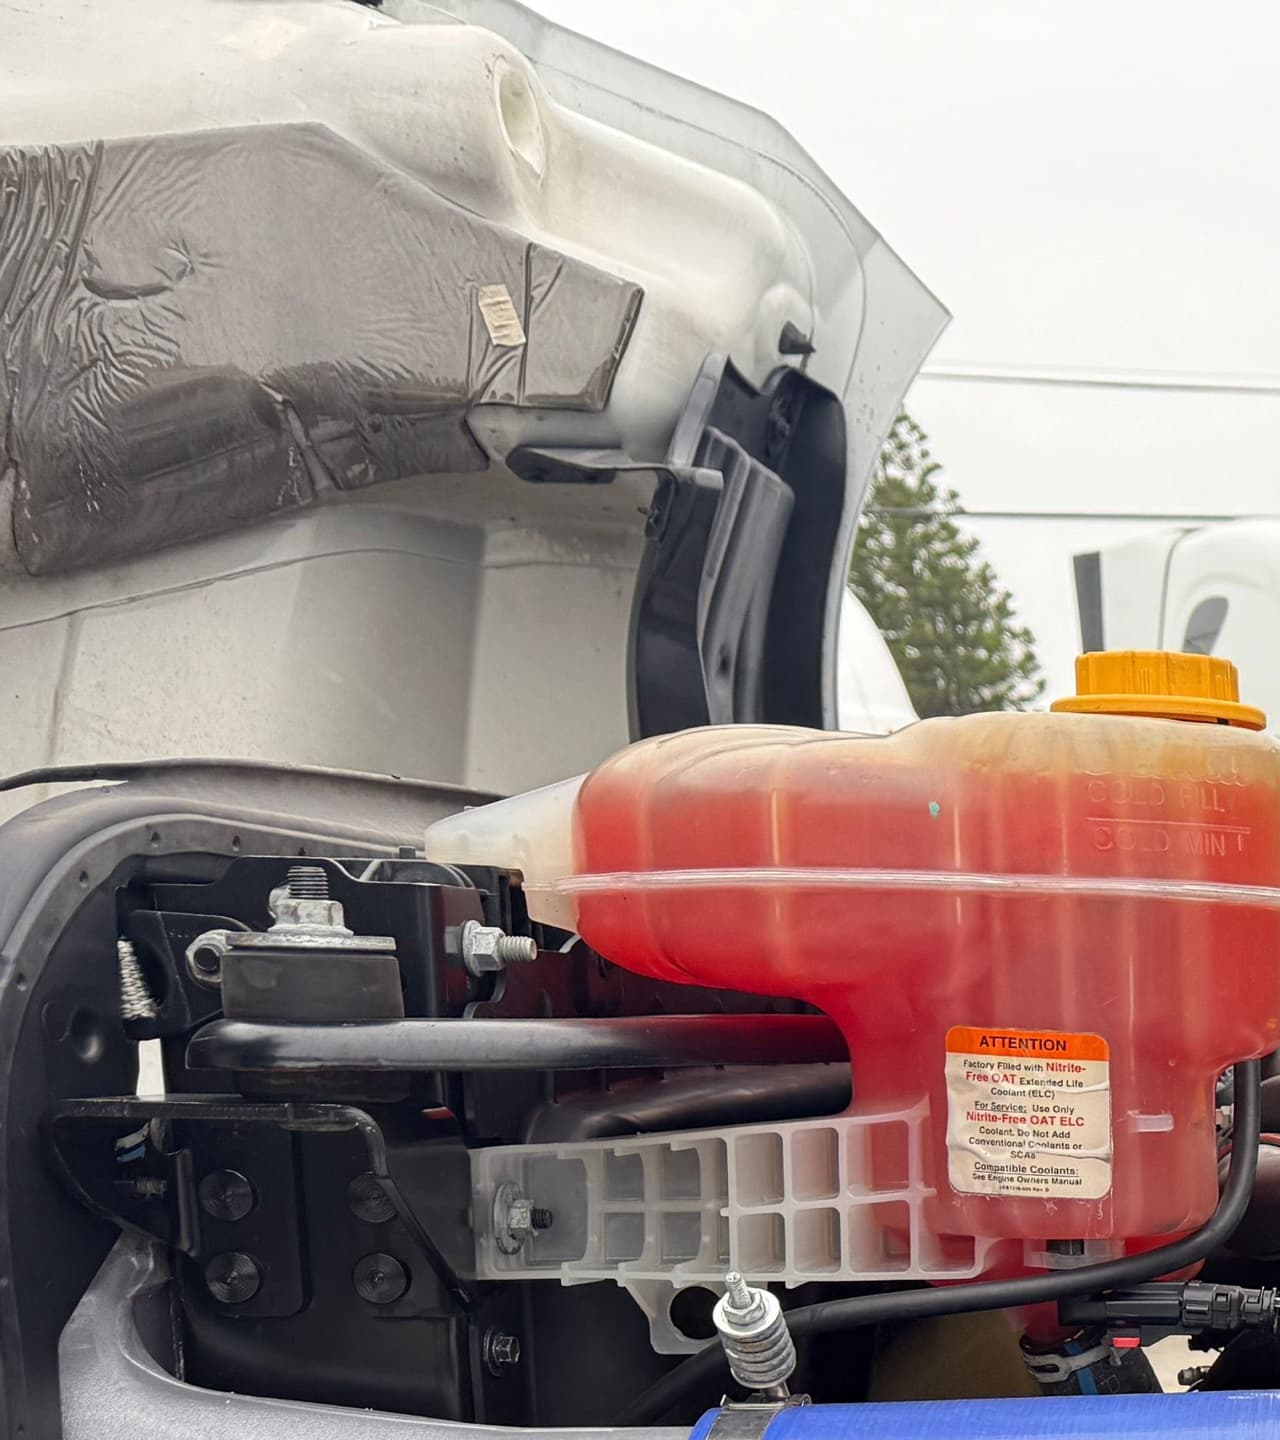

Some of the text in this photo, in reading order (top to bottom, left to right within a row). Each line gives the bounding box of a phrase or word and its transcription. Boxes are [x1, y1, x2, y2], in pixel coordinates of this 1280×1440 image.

[1087, 780, 1225, 812] COLD FILL
[1092, 826, 1225, 856] COLD MIN
[979, 1035, 1067, 1051] ATTENTION
[963, 1059, 1086, 1073] Factory Filled with Nitrite-
[966, 1072, 1084, 1088] Free OAT Extended Life
[990, 1088, 1056, 1100] Coolant (ELC)
[974, 1101, 1075, 1115] For Service: Use Only
[966, 1112, 1085, 1127] Nitrite-Free OAT ELC
[1018, 1128, 1030, 1137] Do
[1032, 1129, 1049, 1138] Not
[1051, 1130, 1071, 1139] Add
[968, 1137, 1026, 1148] Conventional
[1028, 1140, 1070, 1149] Coolants
[974, 1162, 1079, 1175] Compatible Coolants:
[987, 1174, 1014, 1184] Engine
[1016, 1176, 1049, 1185] Owners
[1051, 1177, 1082, 1185] Manual
